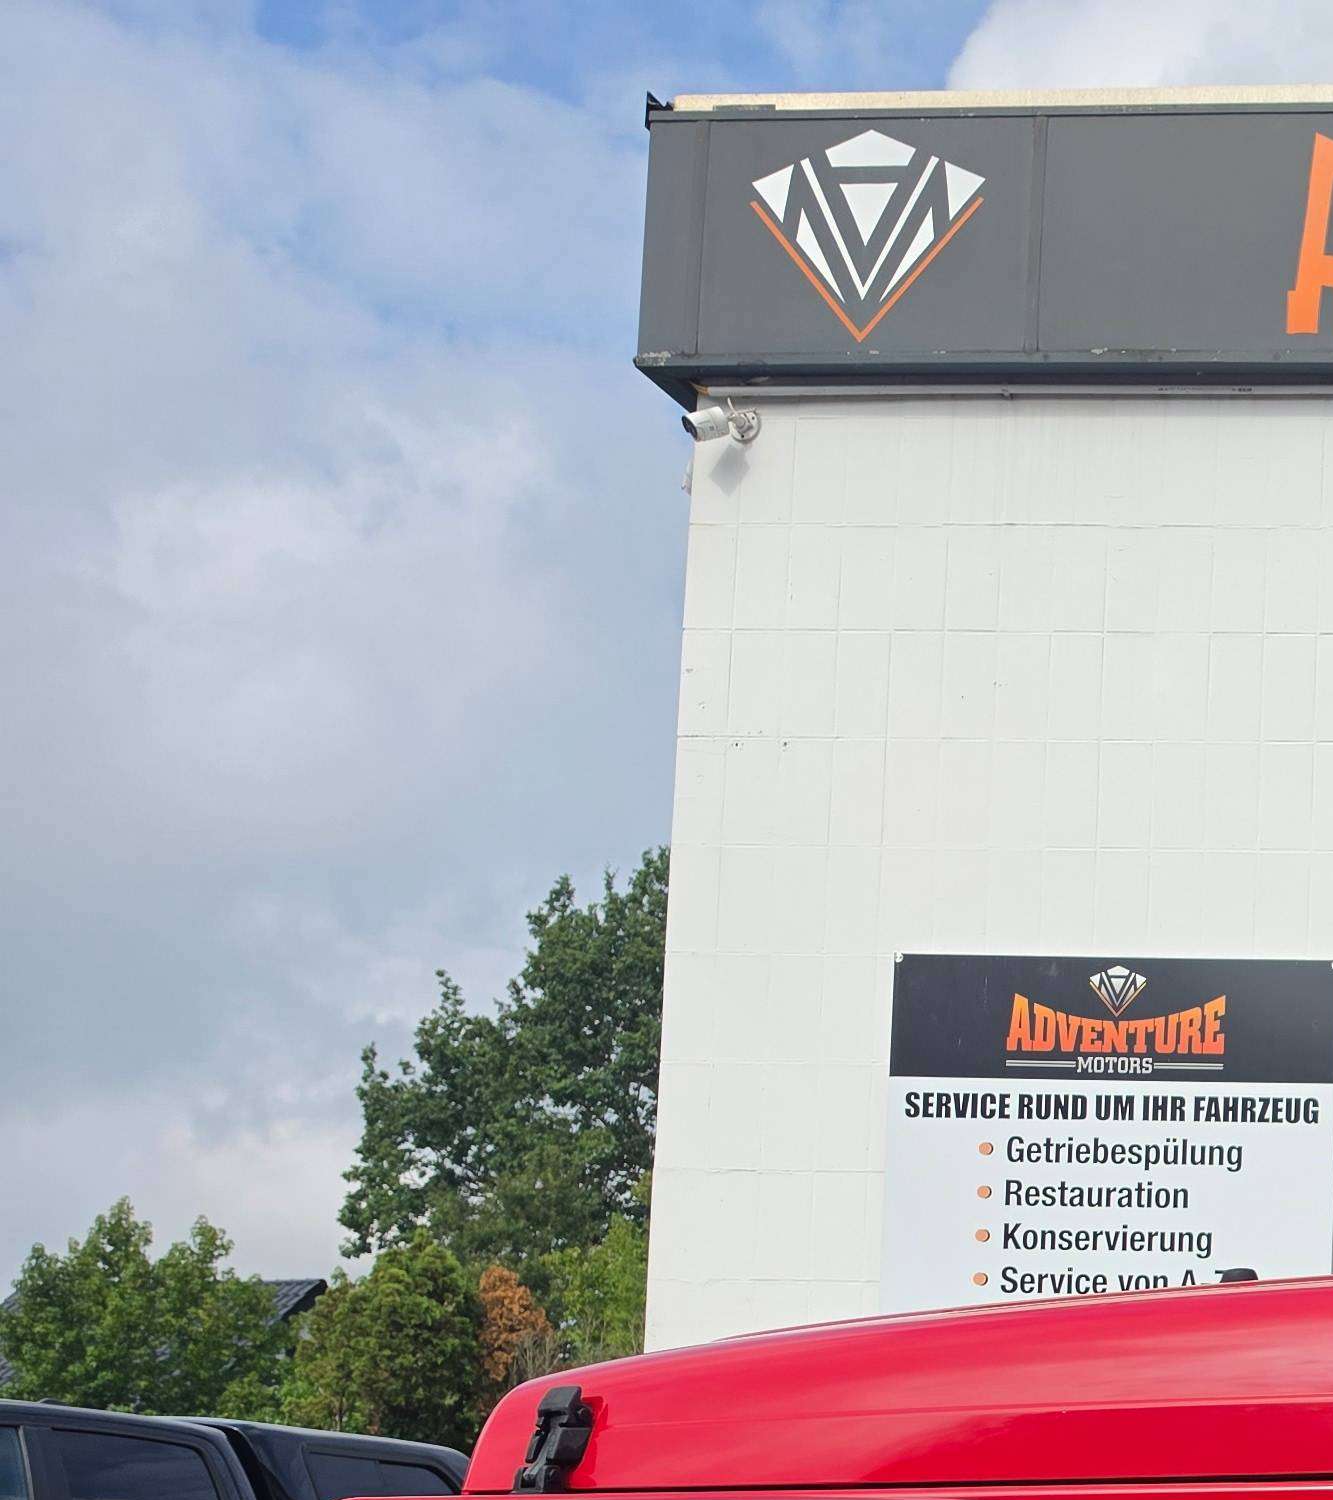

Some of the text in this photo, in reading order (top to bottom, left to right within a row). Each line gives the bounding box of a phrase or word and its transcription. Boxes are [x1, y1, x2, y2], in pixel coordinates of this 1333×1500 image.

[1005, 993, 1226, 1056] ADVENTURE
[1076, 1056, 1153, 1075] MOTORS
[904, 1091, 1320, 1124] SERVICE RUND UM IHR FAHRZEUG
[1005, 1135, 1244, 1172] Getriebespülung
[1004, 1179, 1189, 1208] Restauration
[1002, 1223, 1213, 1259] Konservierung
[1000, 1266, 1107, 1294] Service
[1118, 1273, 1168, 1291] von
